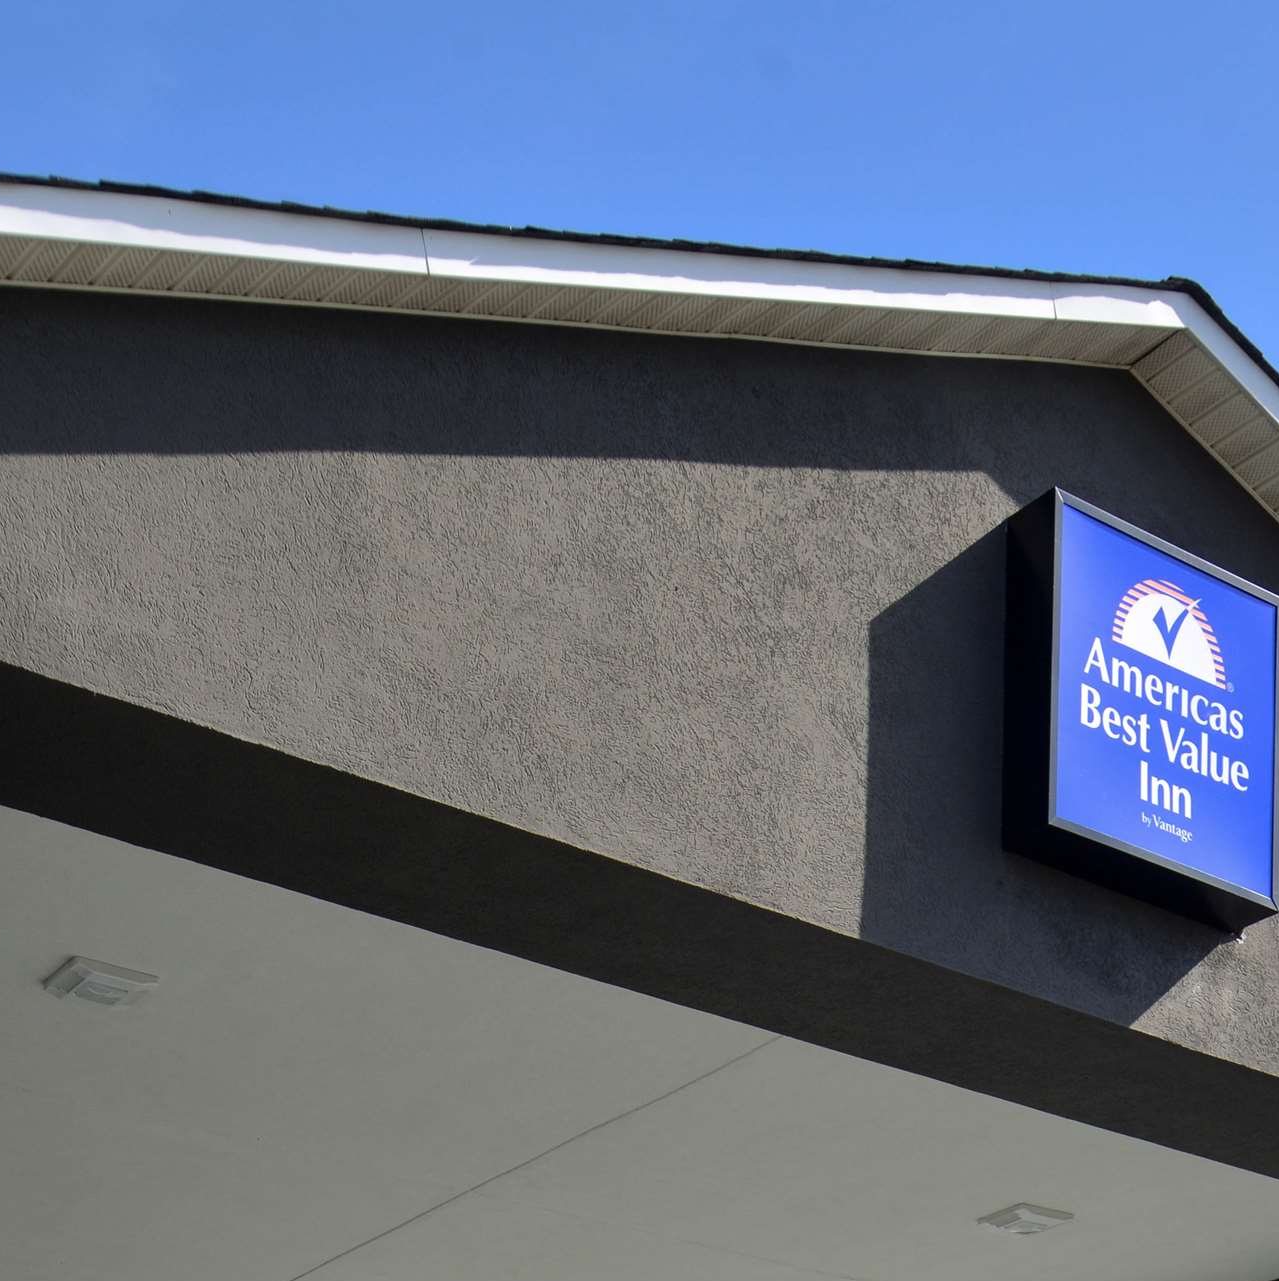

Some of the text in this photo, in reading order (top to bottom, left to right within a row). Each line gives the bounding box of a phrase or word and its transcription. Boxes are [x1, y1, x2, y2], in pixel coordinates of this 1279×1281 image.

[1083, 636, 1244, 740] Americas
[1080, 682, 1249, 792] Best Value
[1140, 760, 1192, 819] Inn
[1141, 811, 1193, 843] by Vantage
